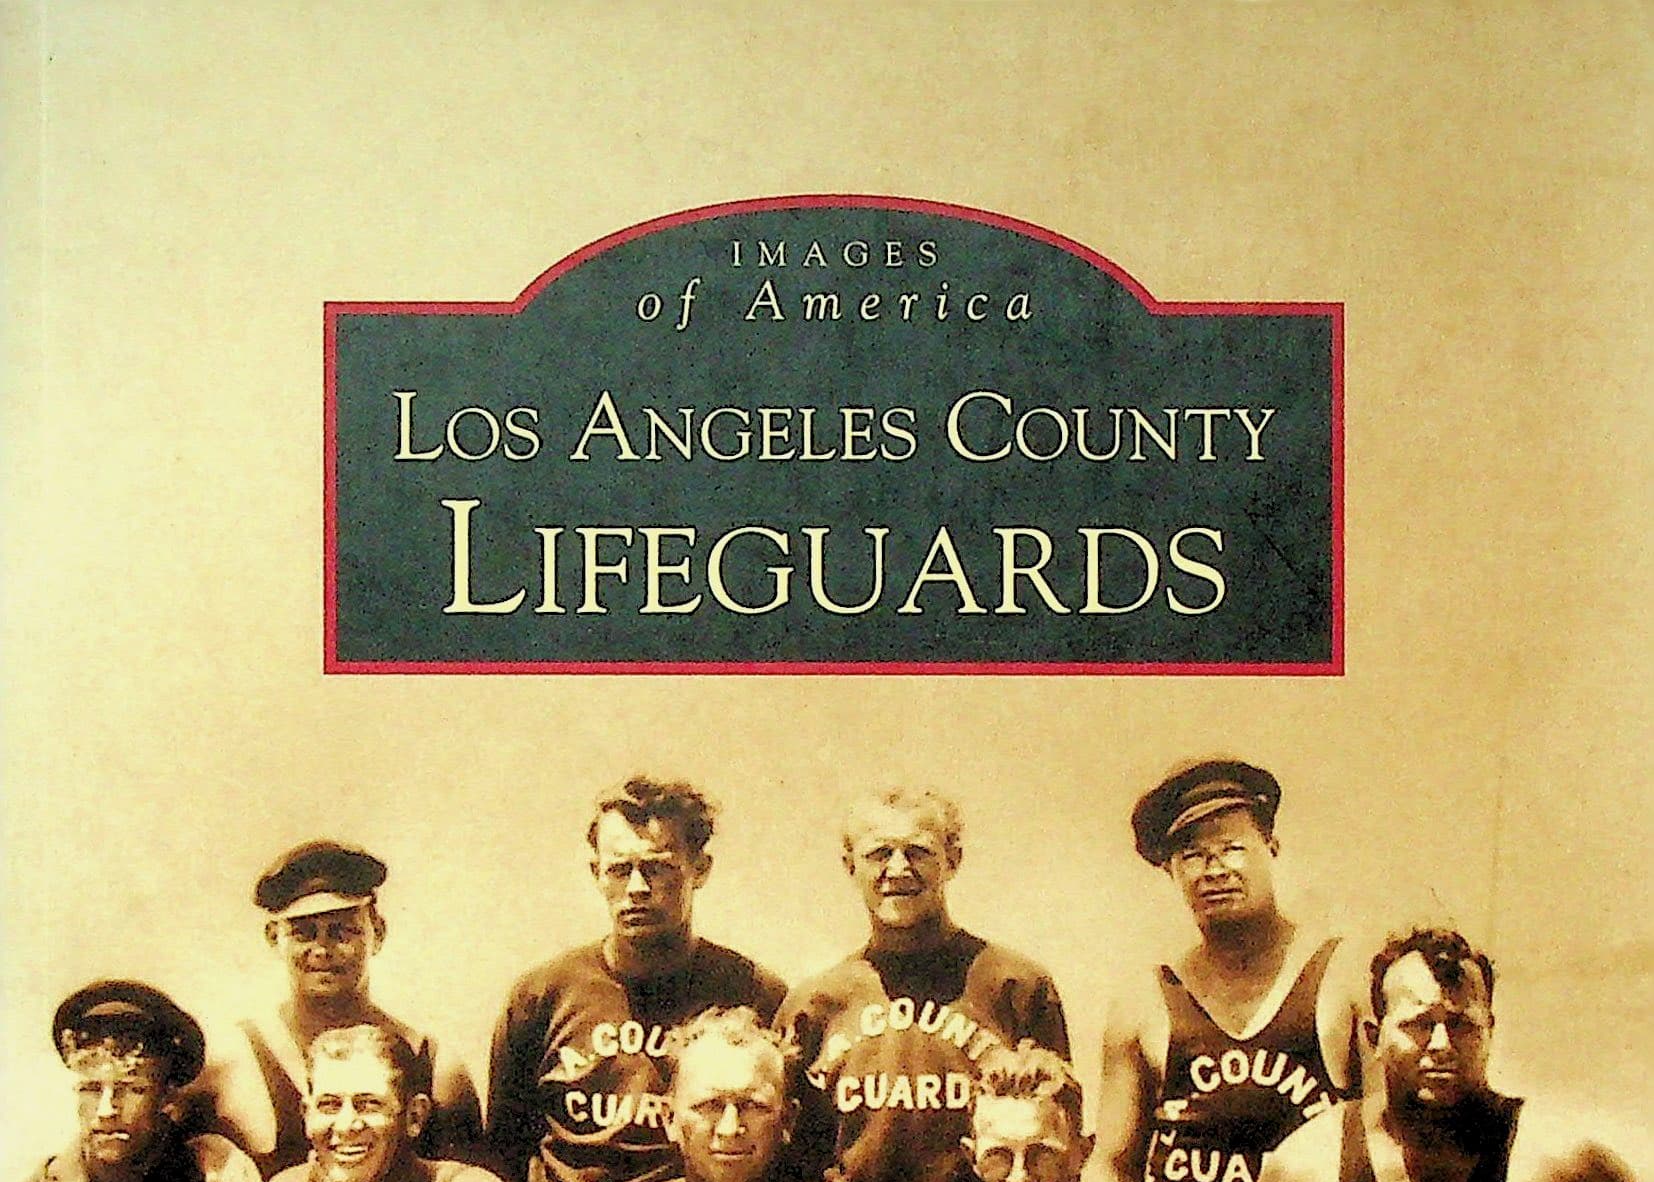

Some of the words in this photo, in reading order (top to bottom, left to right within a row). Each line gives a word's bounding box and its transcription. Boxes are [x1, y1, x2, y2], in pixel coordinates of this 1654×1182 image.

[732, 240, 938, 268] IMAGES
[638, 278, 701, 330] of
[745, 280, 1033, 321] America
[392, 391, 540, 461] LOS
[569, 390, 917, 462] ANGELES
[947, 391, 1276, 462] COUNTY
[441, 498, 1226, 616] LIFEGUARDS
[591, 1020, 672, 1058] COU
[860, 997, 1002, 1061] COUNT
[1189, 1049, 1333, 1120] COUNT
